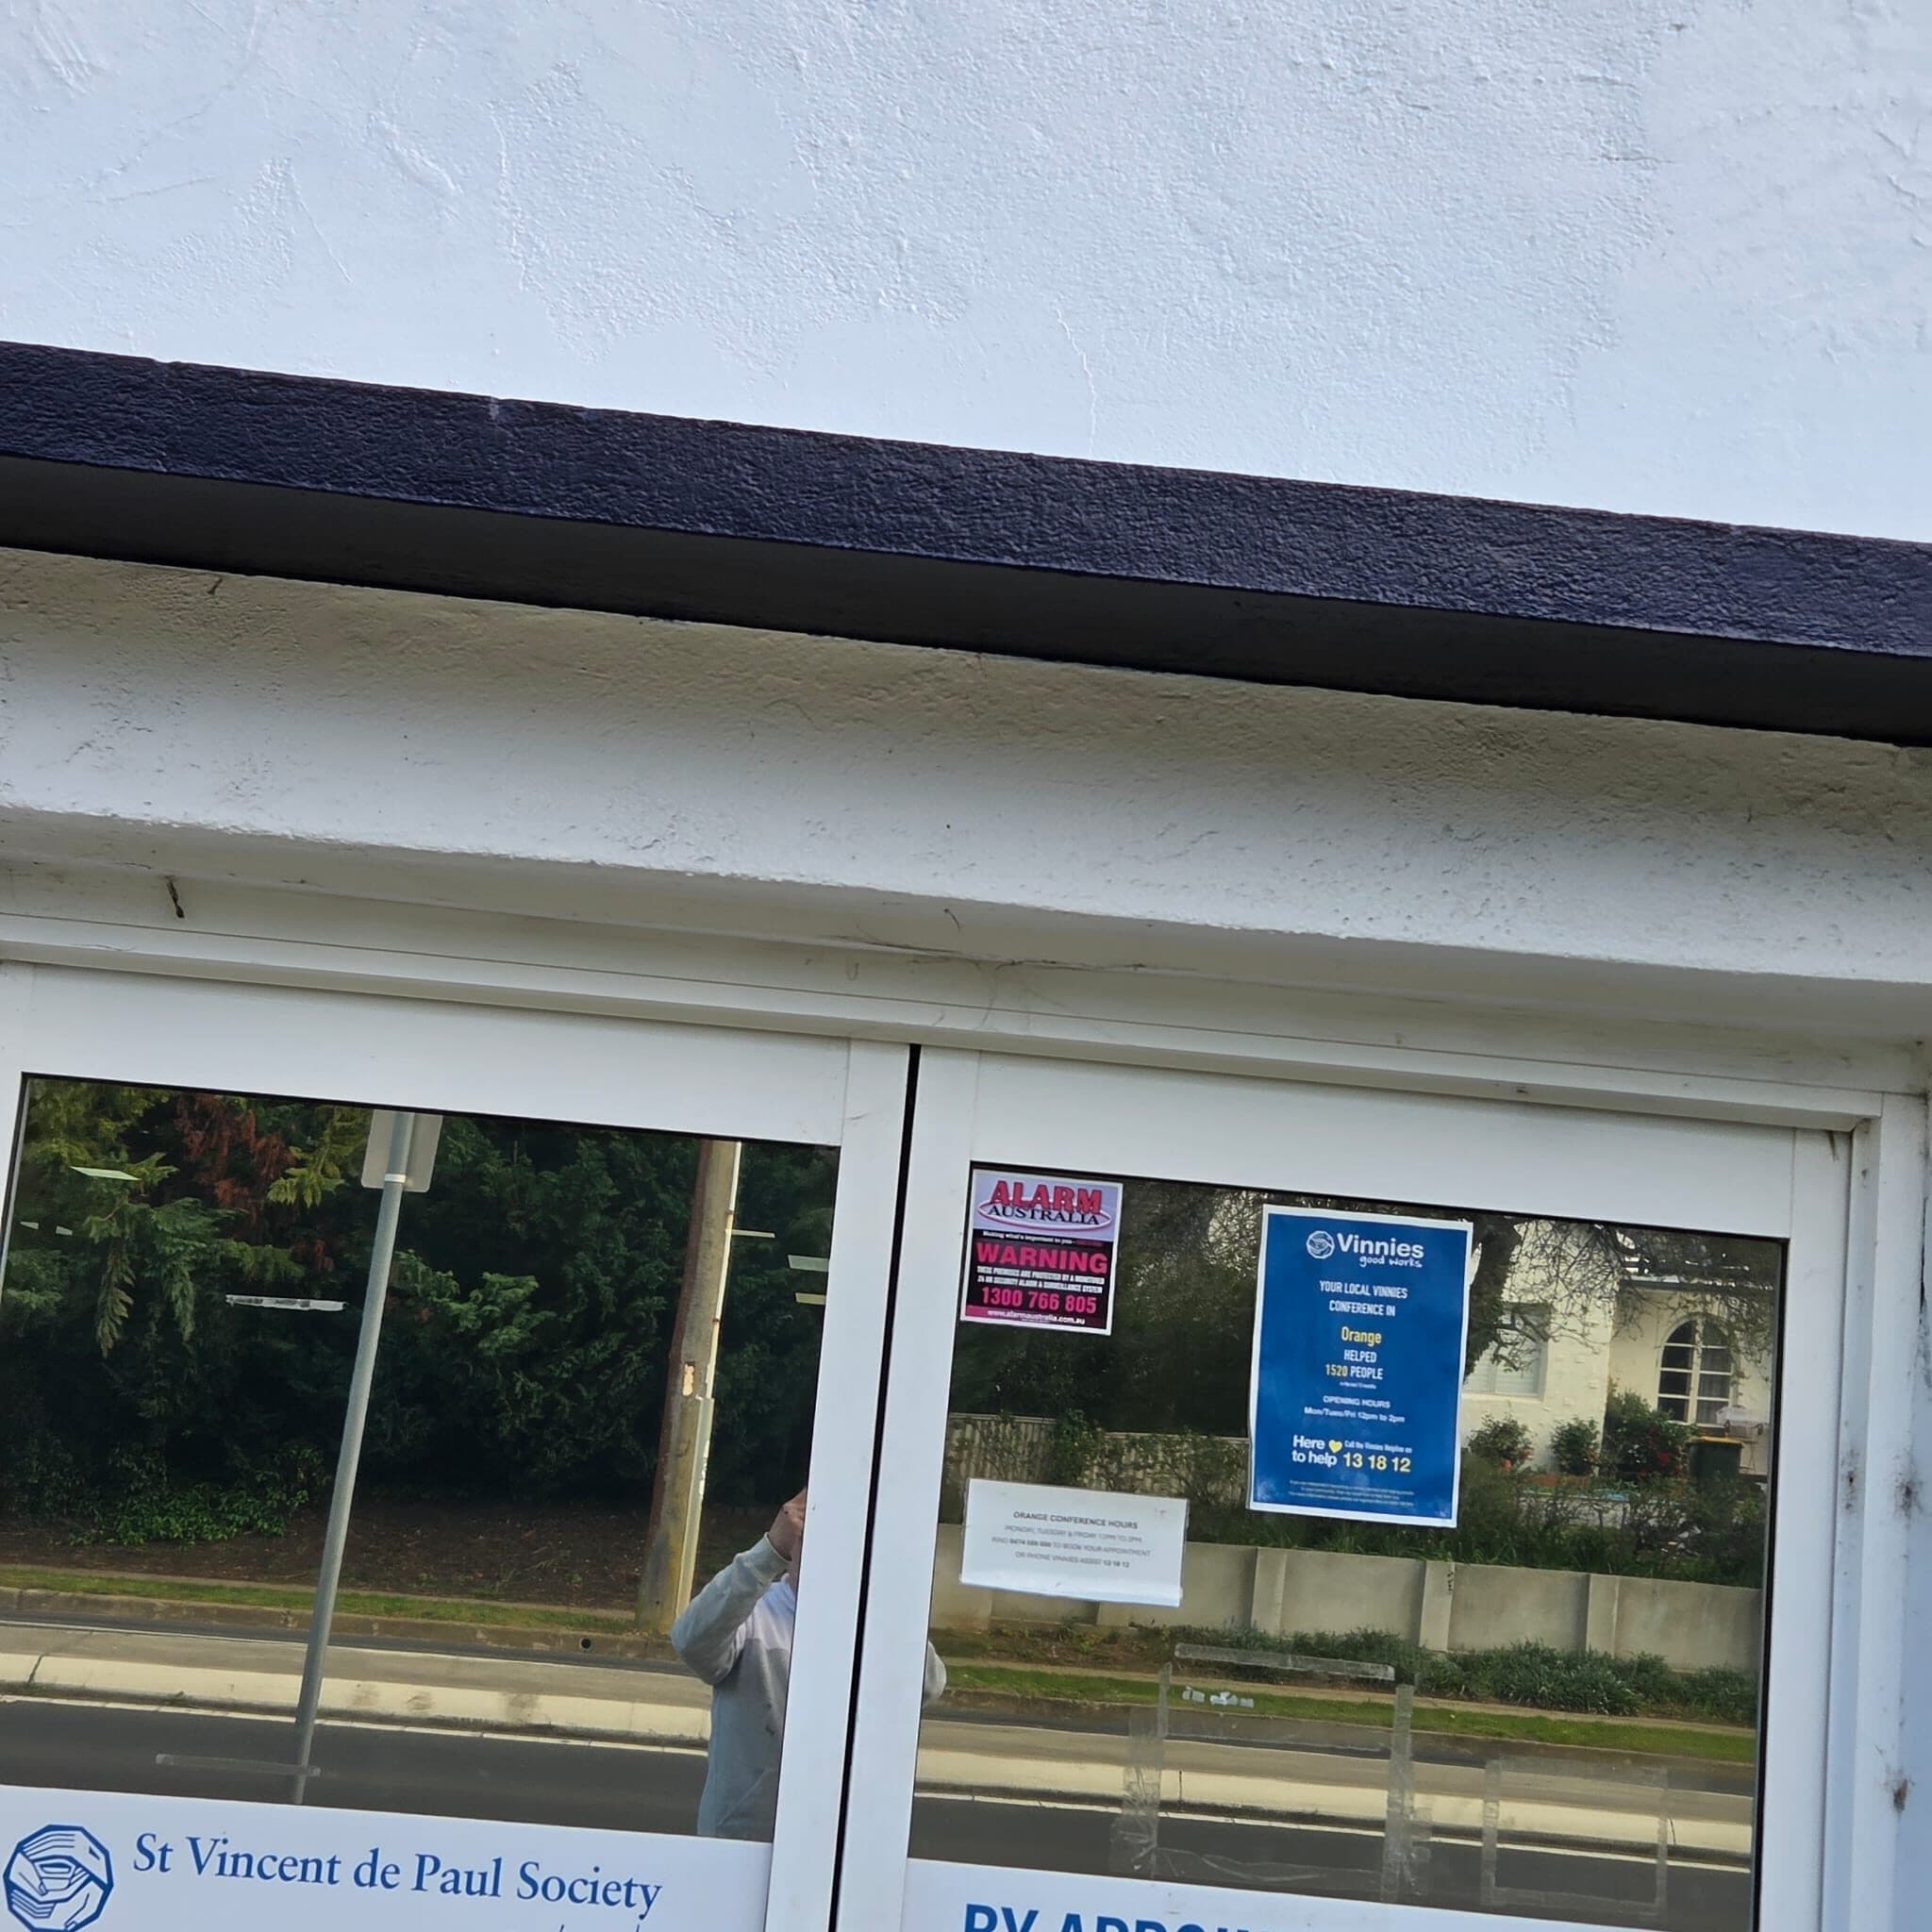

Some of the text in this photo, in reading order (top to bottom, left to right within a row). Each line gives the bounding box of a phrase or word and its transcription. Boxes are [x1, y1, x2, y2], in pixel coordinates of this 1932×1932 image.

[991, 1180, 1103, 1214] ALARM
[988, 1205, 1100, 1224] AUSTRALIA
[1337, 1232, 1424, 1258] Vinnies
[975, 1241, 1108, 1274] WARNING
[1359, 1256, 1385, 1268] good
[1319, 1280, 1408, 1299] YOUR LOCAL VINNIES
[982, 1287, 1097, 1314] 1300 766 805
[1329, 1300, 1396, 1317] CONFERENCE IN
[988, 1309, 1086, 1325] www.alarmaustralia.com.au
[1341, 1325, 1383, 1347] Orange
[1343, 1349, 1377, 1363] HELPED
[1324, 1364, 1384, 1380] 1520 PEOPLE
[1323, 1395, 1391, 1409] OPENING HOURS
[1379, 1413, 1387, 1422] to
[1292, 1434, 1325, 1450] Here
[1291, 1449, 1338, 1468] to help
[1343, 1452, 1411, 1473] 13 18 12
[1013, 1511, 1138, 1529] ORANGE CONFERENCE HOURS
[133, 1832, 663, 1923] St Vincent de Paul Society
